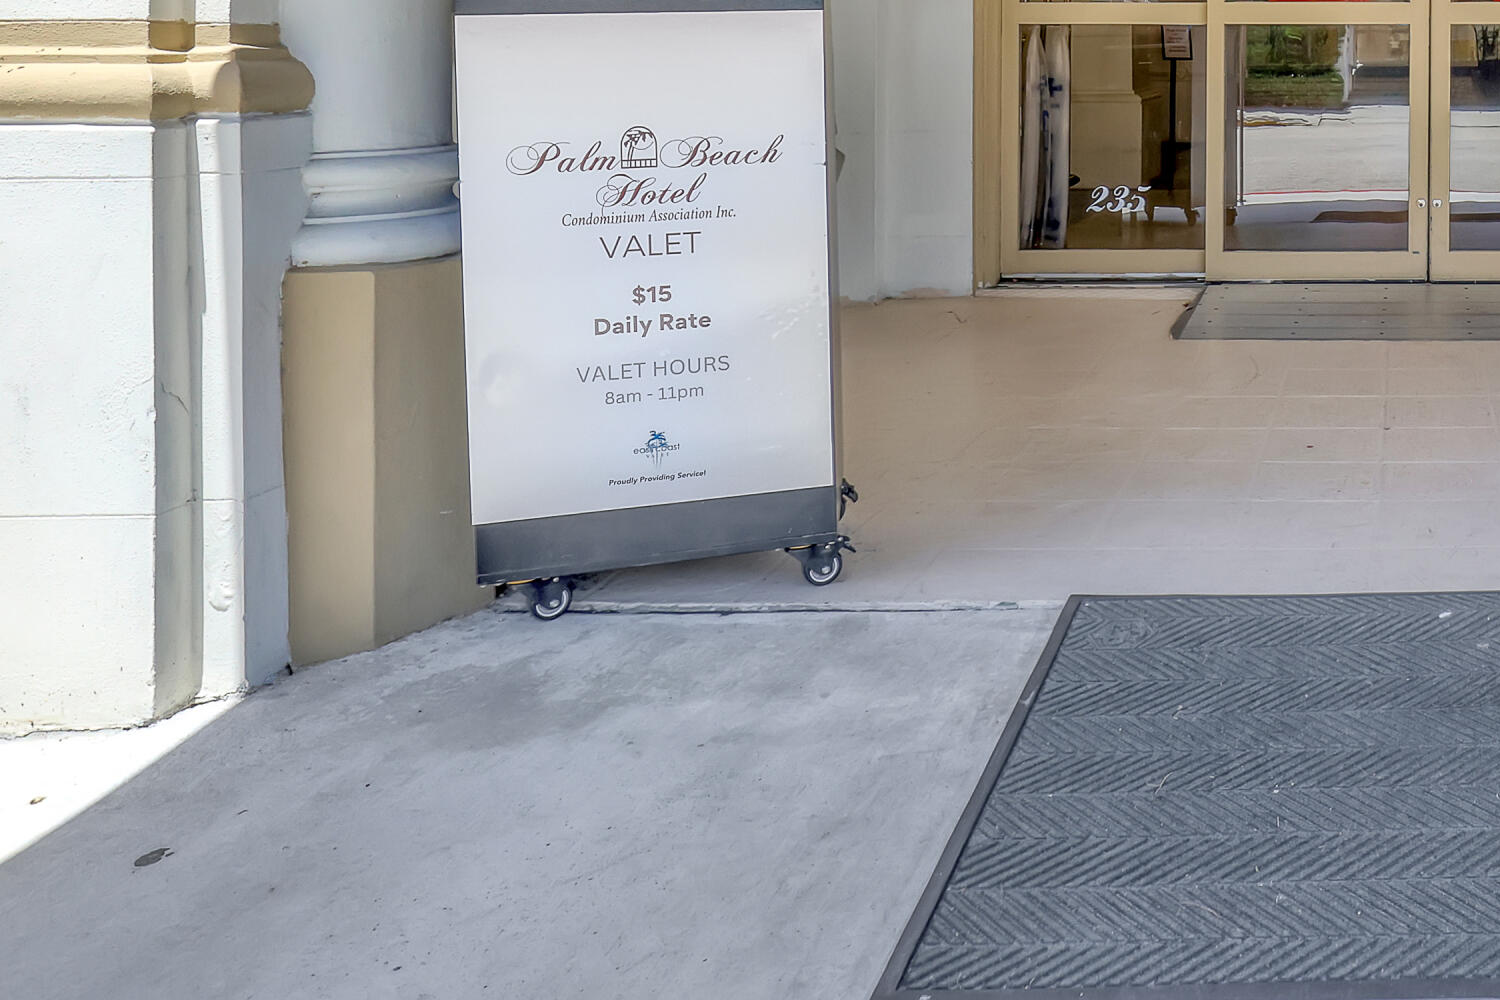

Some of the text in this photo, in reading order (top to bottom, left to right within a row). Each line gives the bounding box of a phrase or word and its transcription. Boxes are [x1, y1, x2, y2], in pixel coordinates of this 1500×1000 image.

[505, 134, 784, 176] Palm Beach
[595, 172, 707, 217] Hotel
[1086, 185, 1152, 213] 235
[561, 205, 737, 227] Condominium Association Inc.
[599, 231, 702, 259] VALET
[632, 284, 672, 306] $15
[594, 313, 712, 338] Daily Rate
[576, 355, 731, 383] VALET HOURS
[604, 391, 642, 405] 8am
[658, 385, 704, 402] 11pm
[608, 470, 707, 487] Proudly Providing Service!
